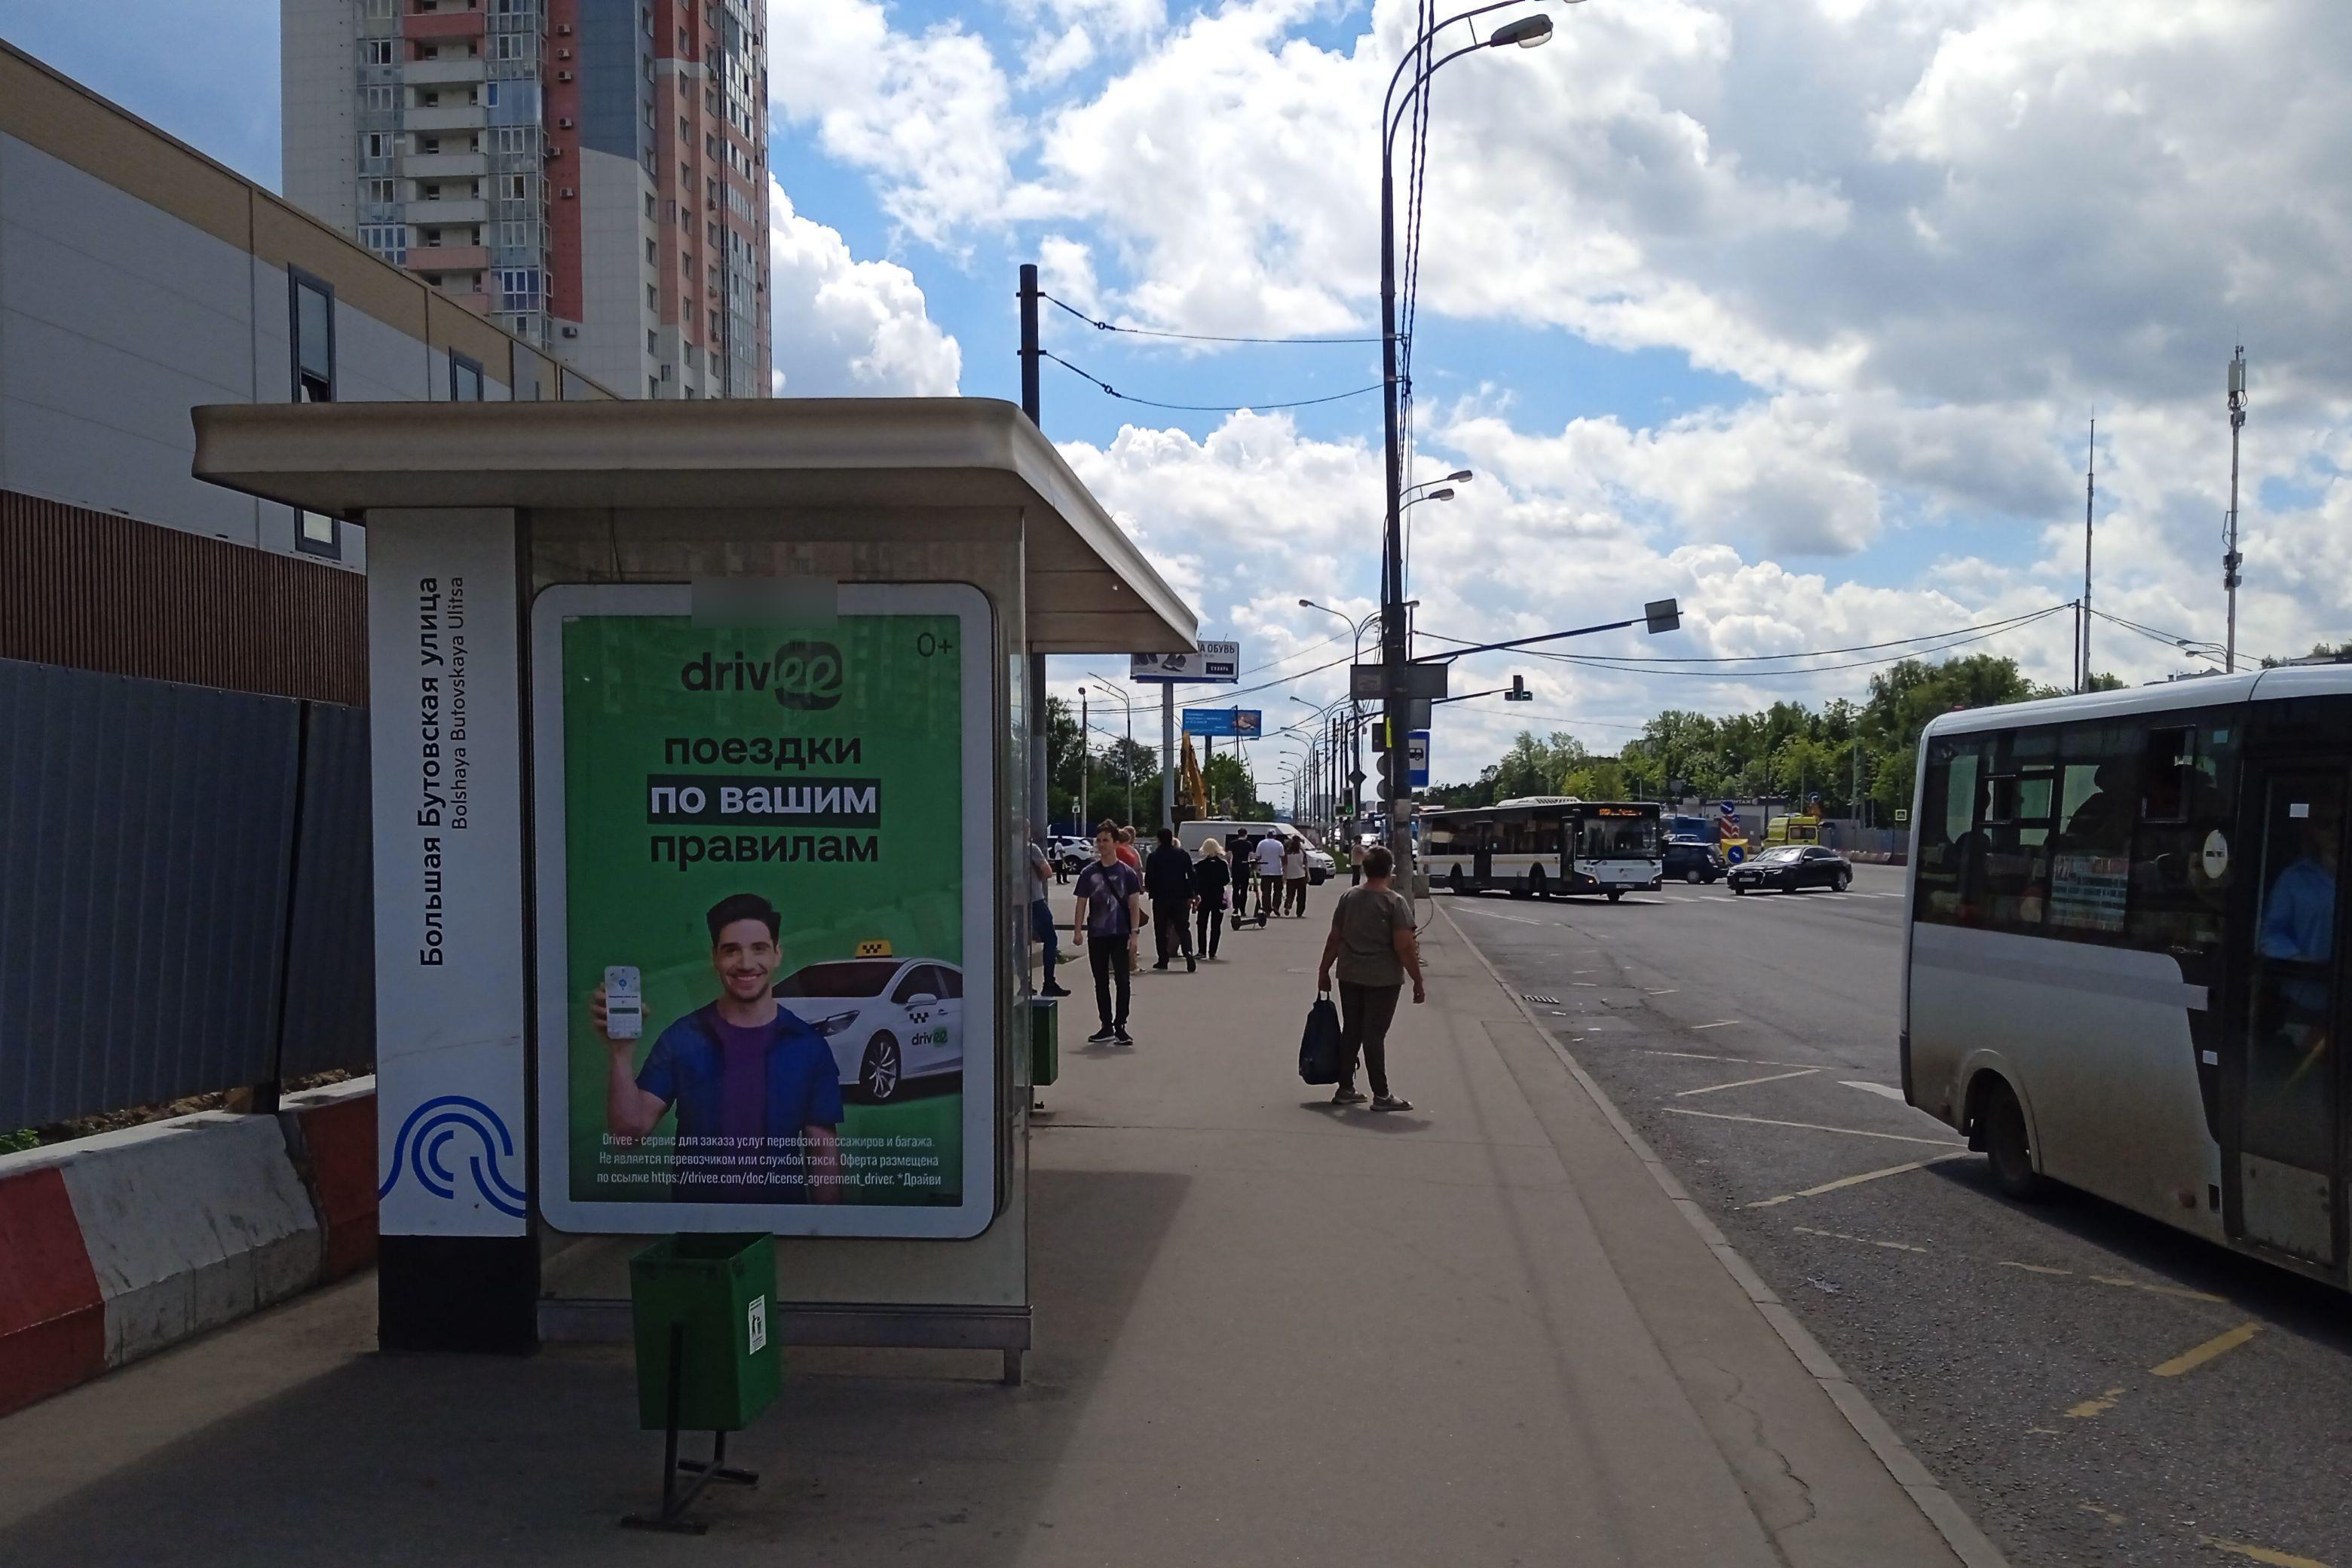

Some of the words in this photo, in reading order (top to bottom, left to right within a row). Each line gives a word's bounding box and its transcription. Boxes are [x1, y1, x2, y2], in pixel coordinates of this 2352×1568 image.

[447, 576, 464, 629] Ulitsa
[419, 577, 445, 665] улица
[916, 632, 953, 657] 0+
[1207, 644, 1235, 654] ОБУВЬ
[449, 633, 469, 741] Butovskaya
[681, 650, 844, 699] drivee
[418, 675, 447, 827] Бутовская
[664, 736, 862, 771] поездки
[451, 746, 471, 830] Bolshaya
[651, 786, 707, 814] по
[720, 786, 877, 814] вашим
[651, 834, 879, 871] правилам
[419, 837, 444, 966] Большая
[911, 1029, 948, 1046] drivee
[602, 1132, 632, 1147] Drivee
[641, 1135, 676, 1148] сервис
[678, 1135, 699, 1147] для
[700, 1135, 735, 1147] заказа
[737, 1136, 765, 1150] услуг
[767, 1136, 820, 1150] перевозки
[822, 1136, 884, 1150] пассажиров
[886, 1137, 893, 1147] и
[896, 1135, 936, 1147] багажа.
[596, 1172, 609, 1184] по
[611, 1172, 649, 1184] ссылке
[599, 1152, 612, 1165] Не
[614, 1153, 662, 1165] является
[663, 1154, 737, 1167] перевозчиком
[738, 1154, 758, 1165] или
[759, 1153, 804, 1168] службой
[806, 1155, 838, 1165] такси.
[840, 1153, 877, 1168] Оферта
[879, 1155, 939, 1168] размещена
